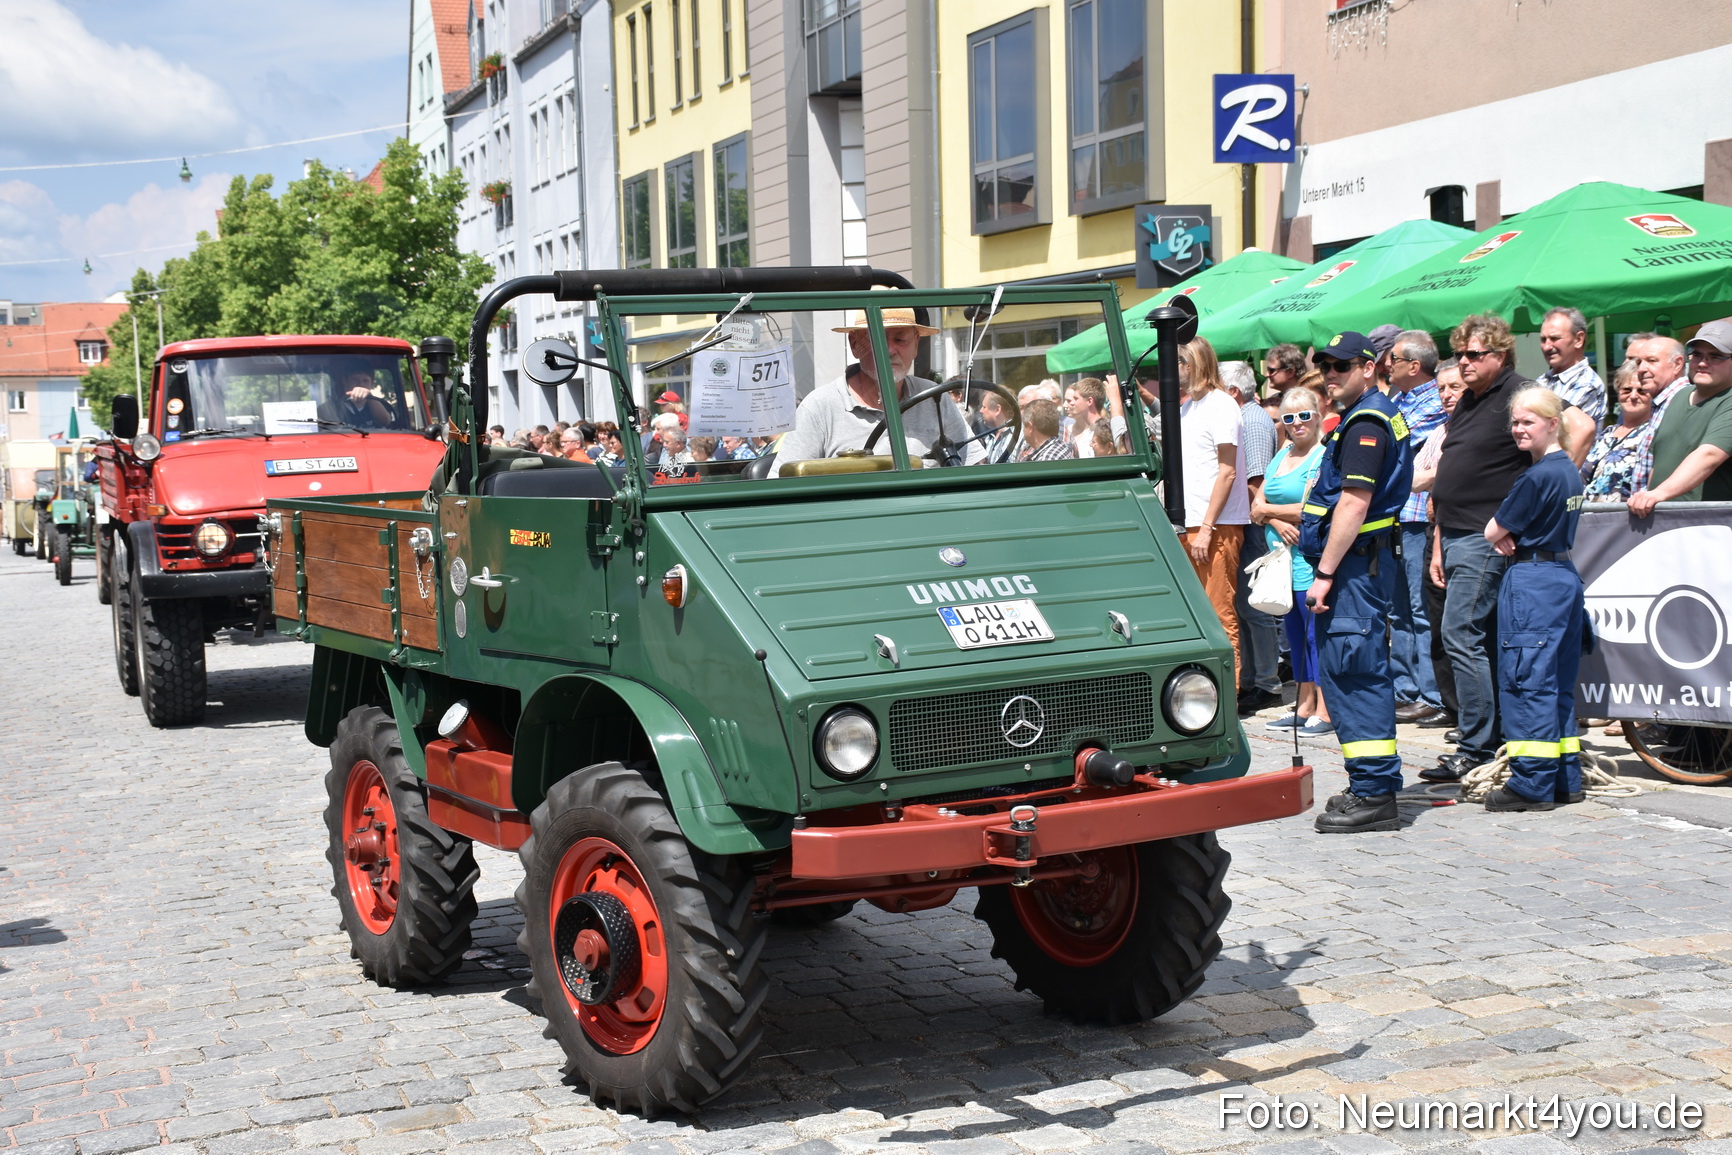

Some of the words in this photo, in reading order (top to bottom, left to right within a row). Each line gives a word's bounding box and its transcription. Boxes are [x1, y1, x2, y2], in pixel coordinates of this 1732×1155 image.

[1303, 187, 1330, 204] Unterer
[1331, 181, 1354, 198] Markt
[1356, 176, 1365, 193] 15
[731, 326, 751, 335] nicht
[732, 316, 751, 326] Bitte
[751, 360, 780, 383] 577
[275, 461, 294, 472] EI
[305, 459, 323, 470] ST
[328, 458, 355, 469] 403
[906, 575, 1038, 605] UNIMOG
[956, 604, 1005, 625] LAU
